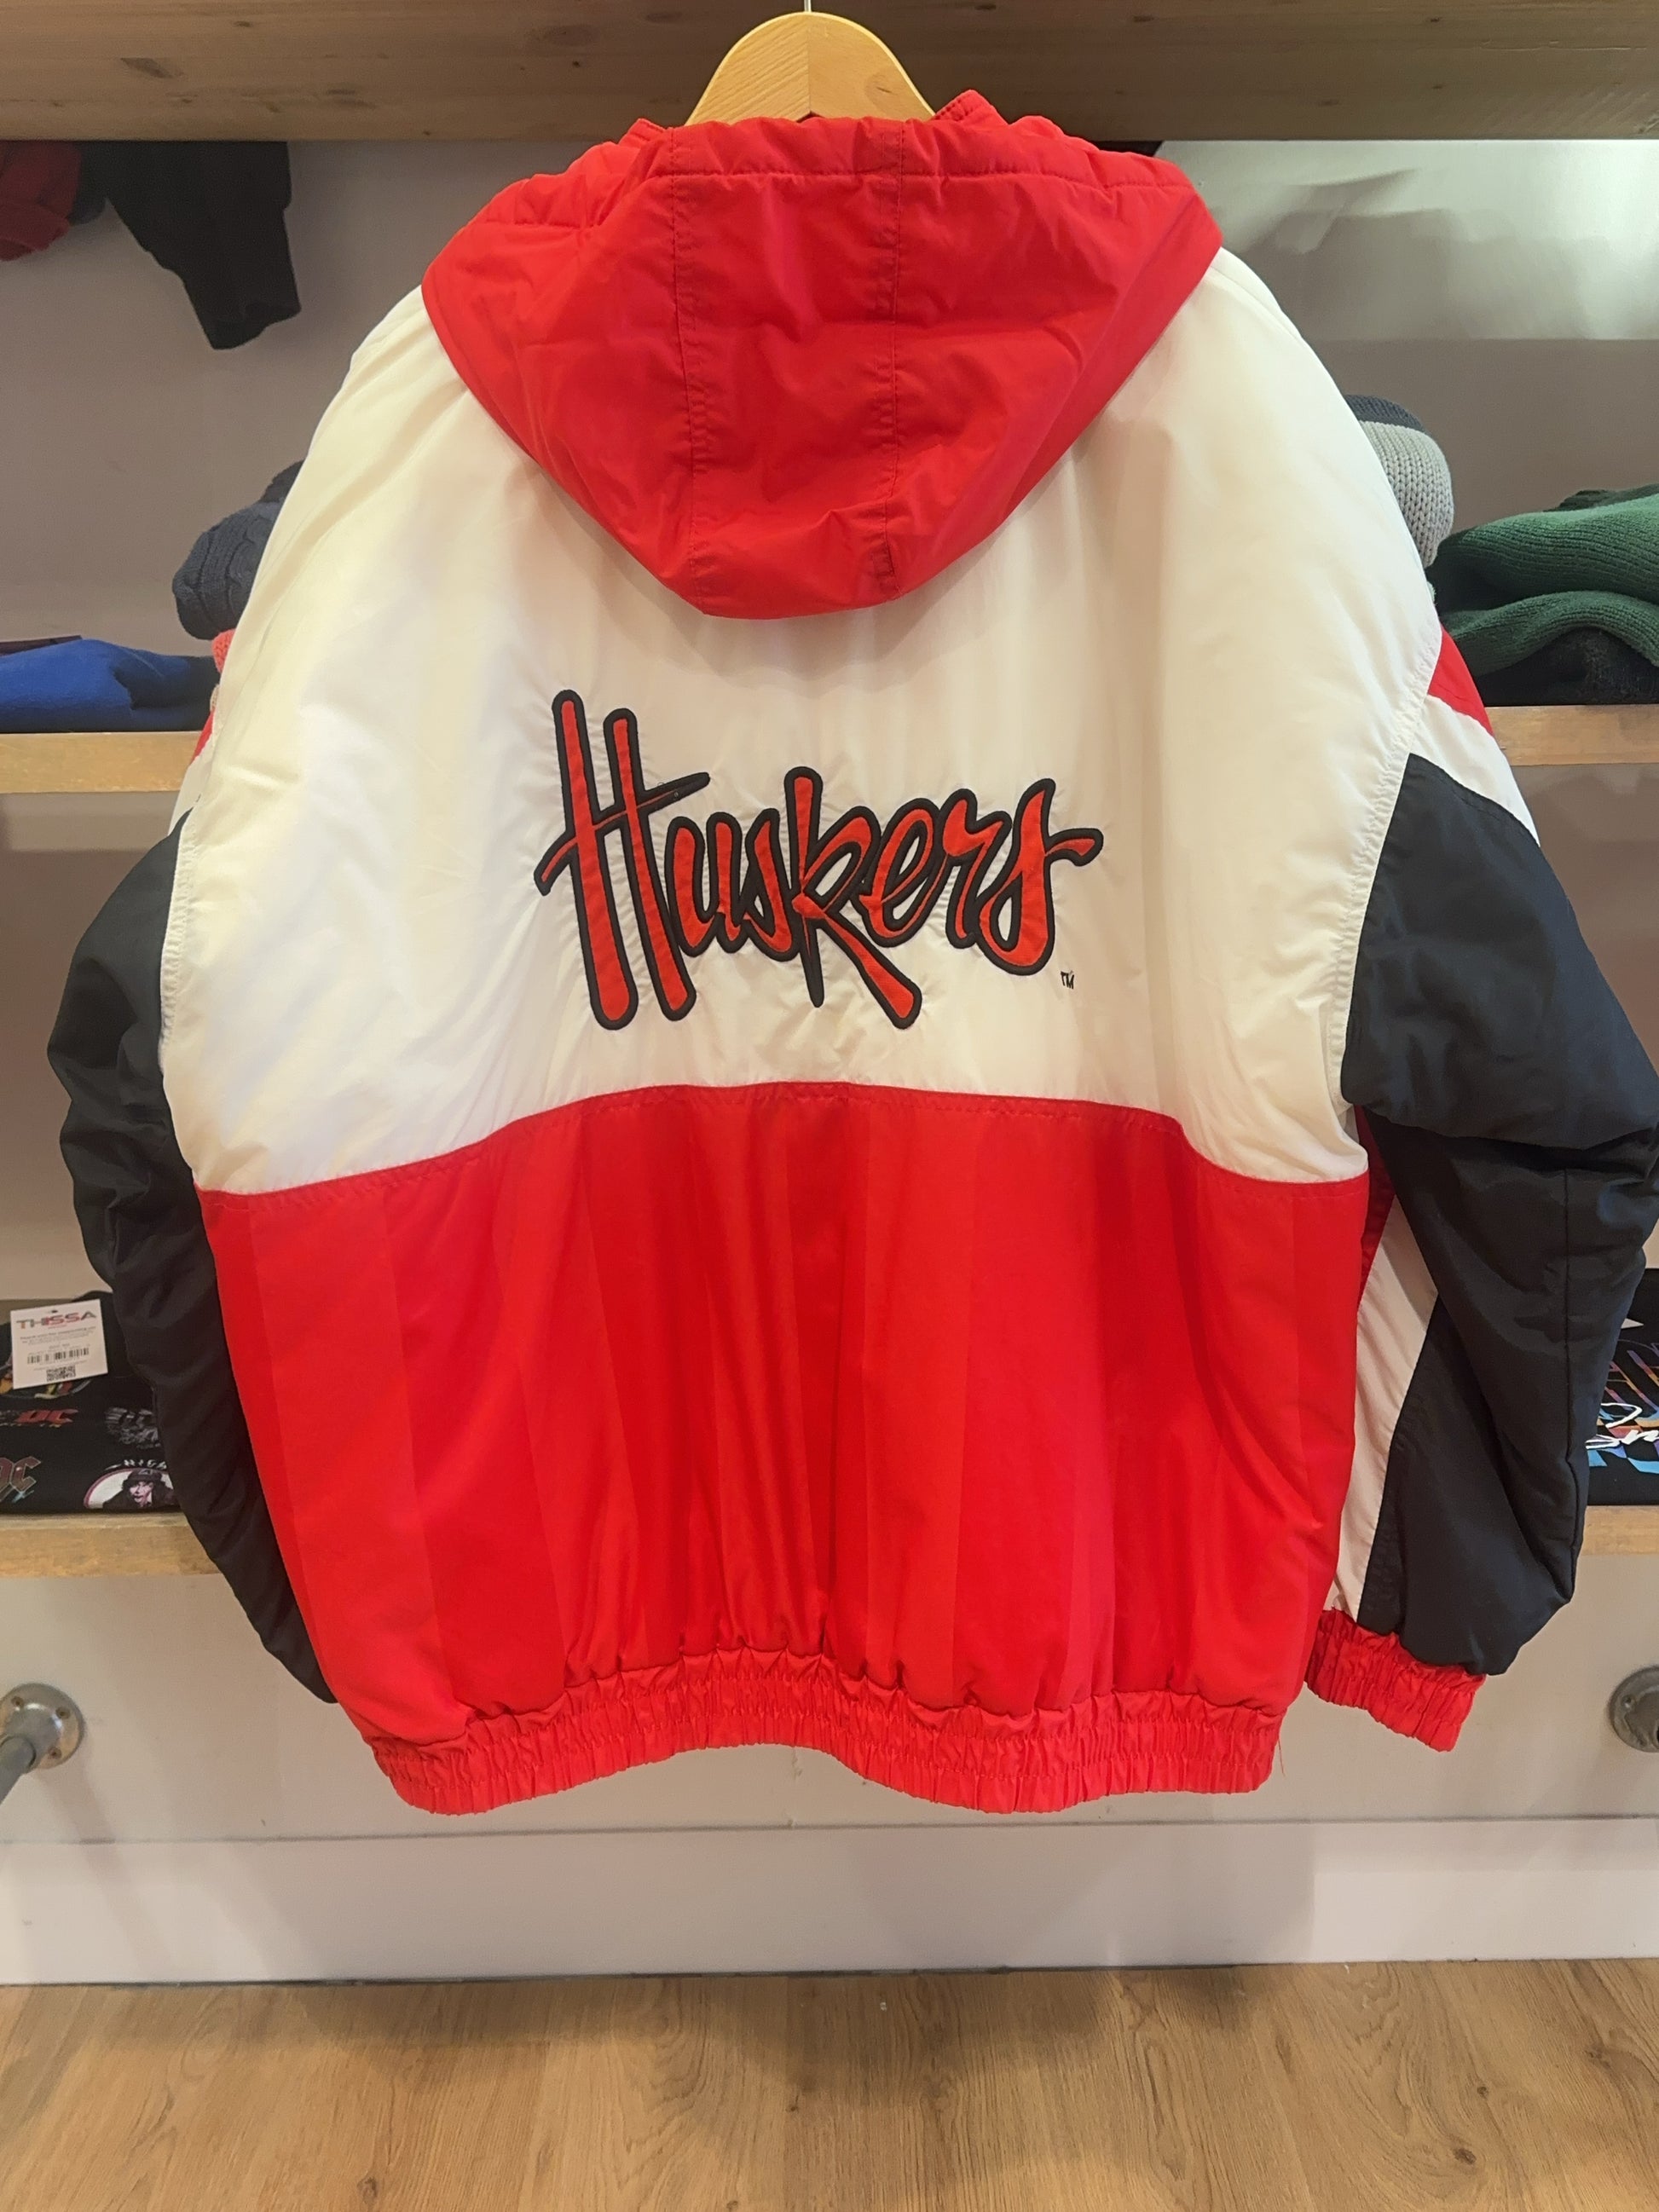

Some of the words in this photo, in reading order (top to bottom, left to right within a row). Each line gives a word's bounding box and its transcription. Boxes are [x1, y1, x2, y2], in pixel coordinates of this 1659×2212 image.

[534, 690, 1103, 1030] Huskers
[1060, 970, 1075, 990] TM
[16, 1310, 97, 1330] THISSA
